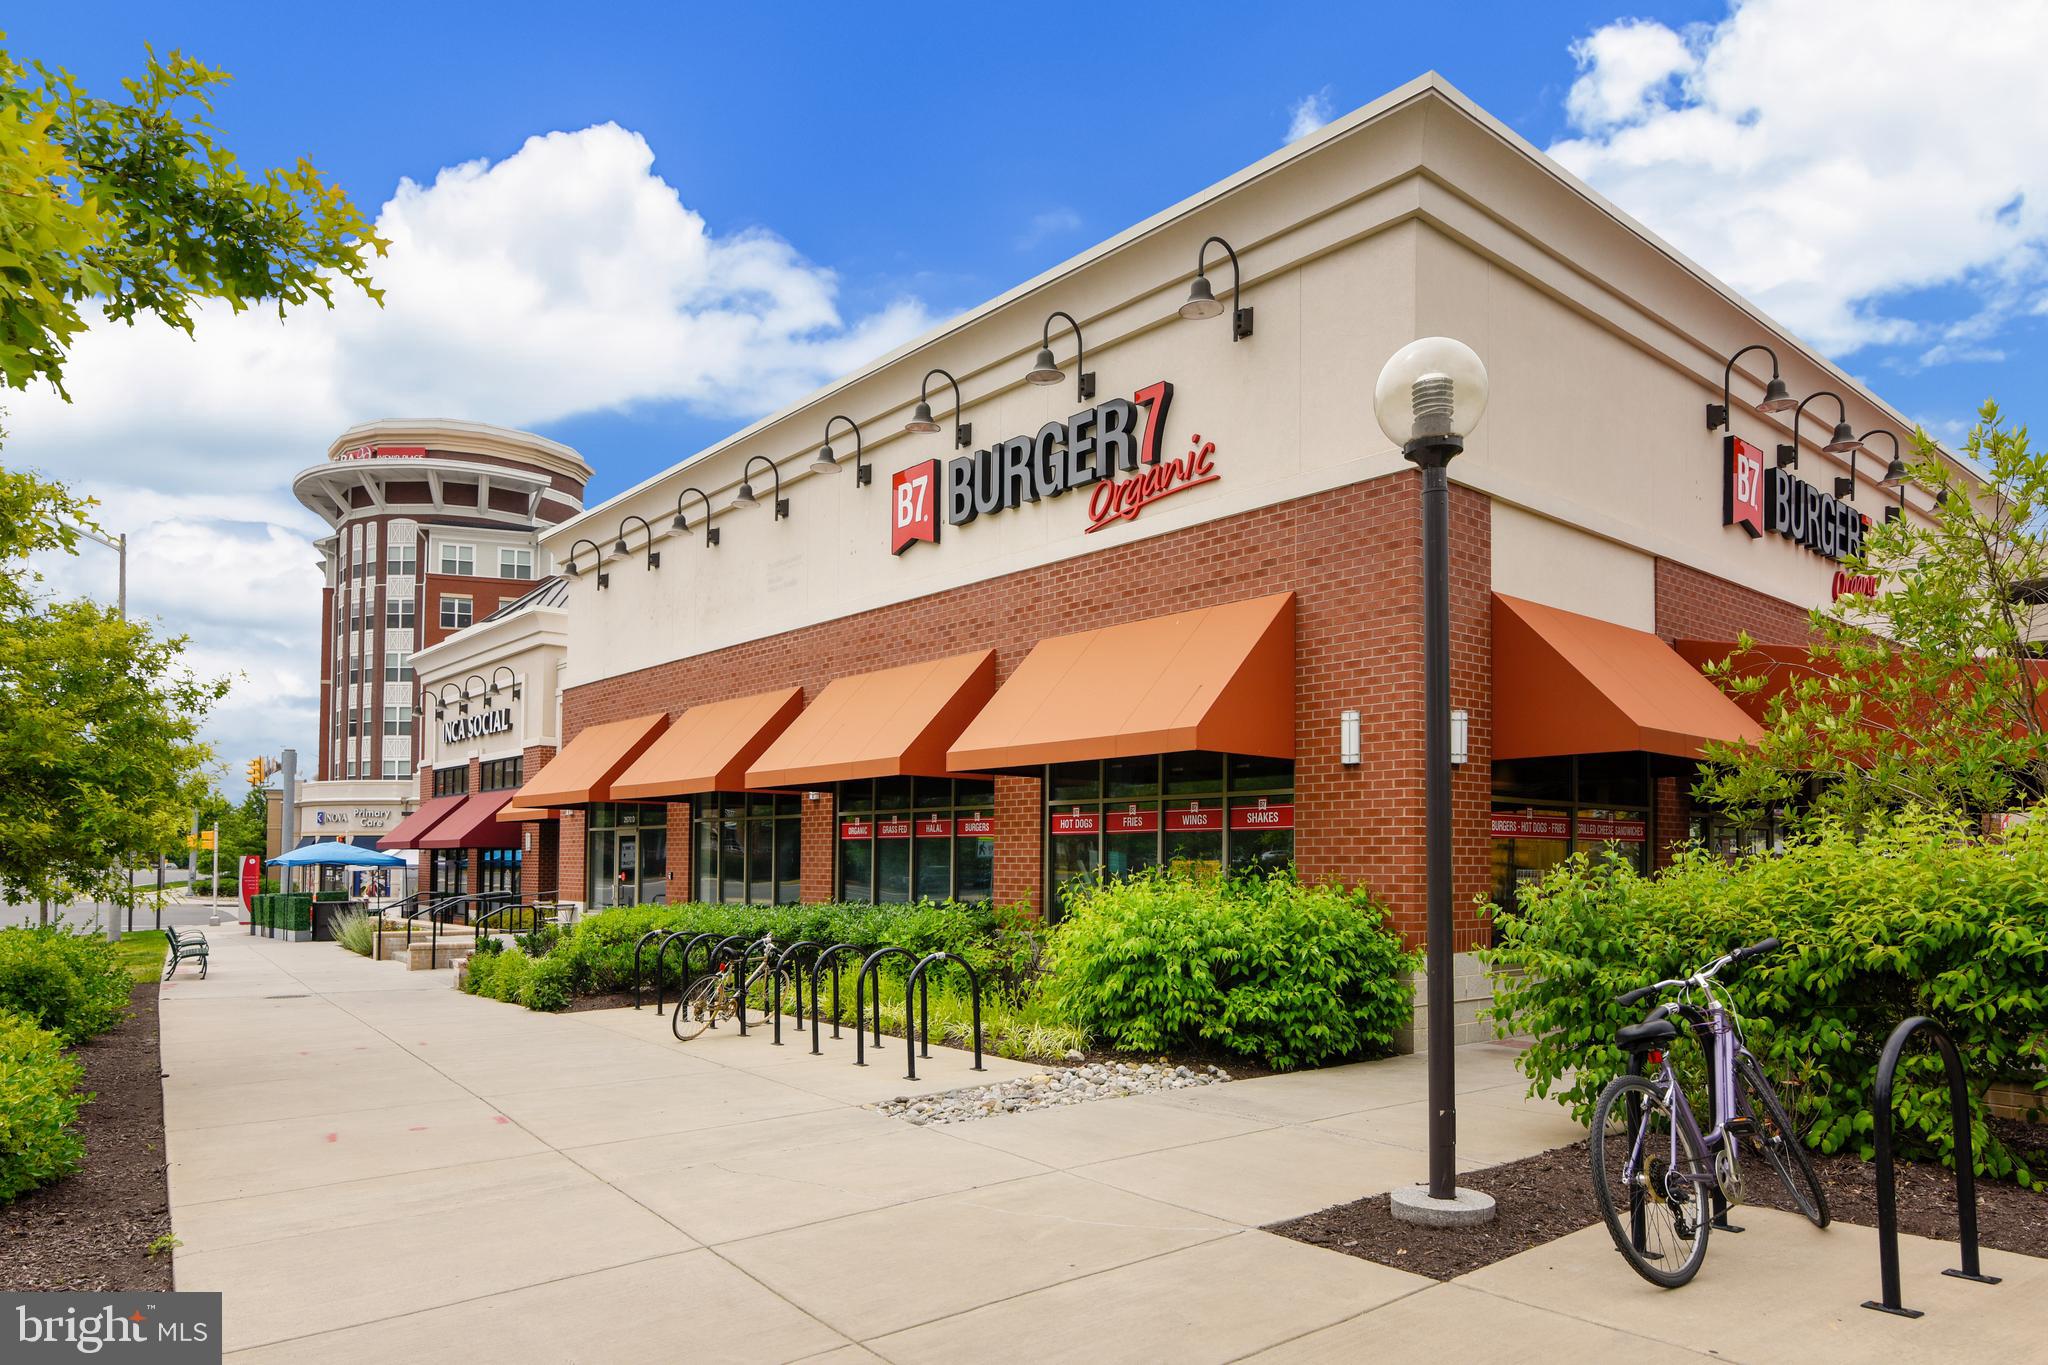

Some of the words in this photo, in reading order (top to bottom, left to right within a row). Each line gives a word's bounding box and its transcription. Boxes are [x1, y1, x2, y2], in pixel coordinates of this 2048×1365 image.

[1086, 434, 1218, 526] Organic
[442, 719, 468, 744] INCA
[467, 708, 512, 738] SOCIAL
[325, 812, 348, 823] NOVA
[353, 808, 391, 819] Primary
[1182, 814, 1208, 825] WINGS
[1246, 811, 1279, 824] SHAKES
[360, 818, 384, 828] Care
[965, 822, 990, 832] BURGERS
[1060, 818, 1074, 829] HOT
[1075, 818, 1093, 829] DOGS
[1122, 816, 1143, 827] FRIES
[1491, 820, 1517, 832] BURGERS
[1520, 822, 1532, 832] HOT
[1533, 822, 1548, 833] DOGS
[1551, 823, 1566, 834] FRIES
[848, 826, 868, 835] ORGANIC
[882, 825, 898, 834] GRASS
[898, 824, 908, 834] FED
[926, 824, 943, 833] HALAL
